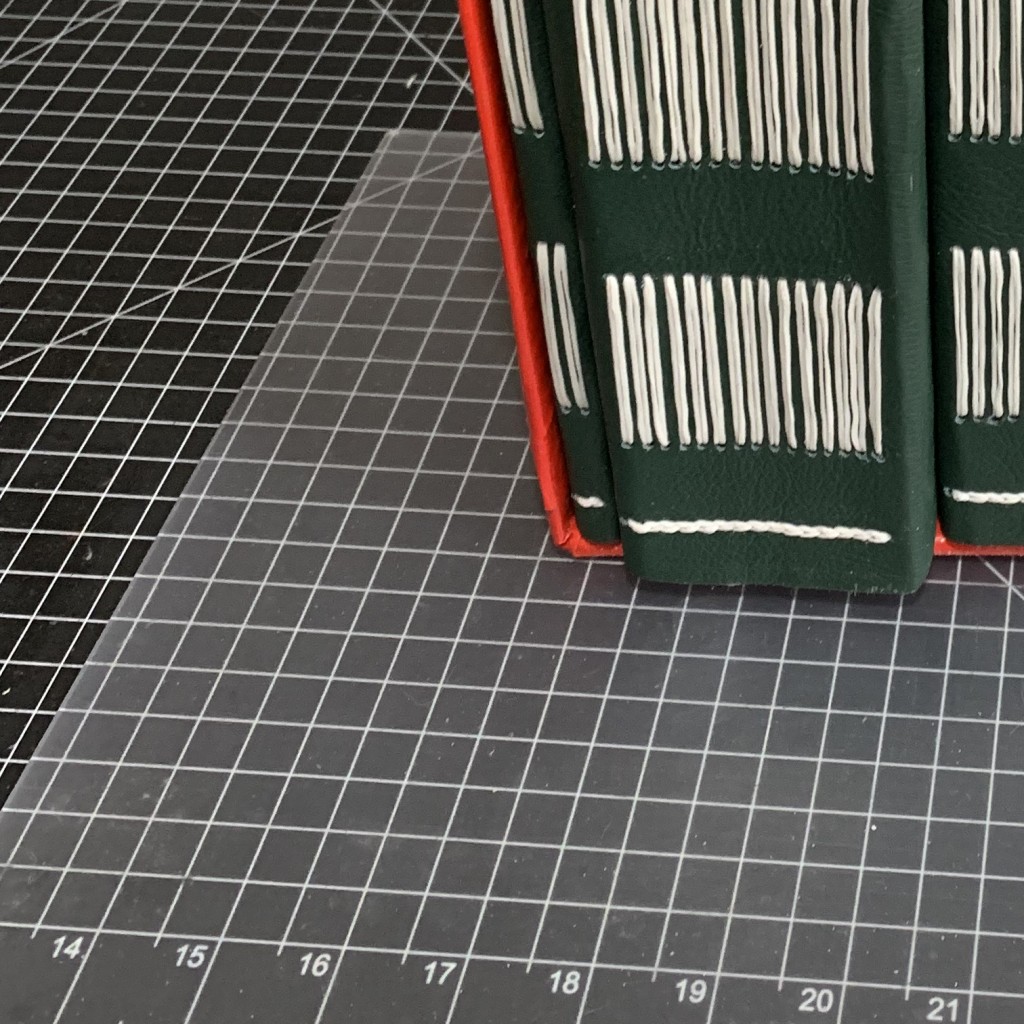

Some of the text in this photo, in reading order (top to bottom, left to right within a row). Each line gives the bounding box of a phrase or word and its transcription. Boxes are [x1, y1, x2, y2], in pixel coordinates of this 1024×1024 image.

[51, 935, 85, 960] 14
[175, 943, 209, 968] 15
[300, 952, 332, 977] 16
[424, 961, 457, 985] 17
[550, 970, 581, 994] 18
[675, 978, 708, 1004] 19
[799, 987, 834, 1013] 20
[927, 996, 960, 1022] 21
